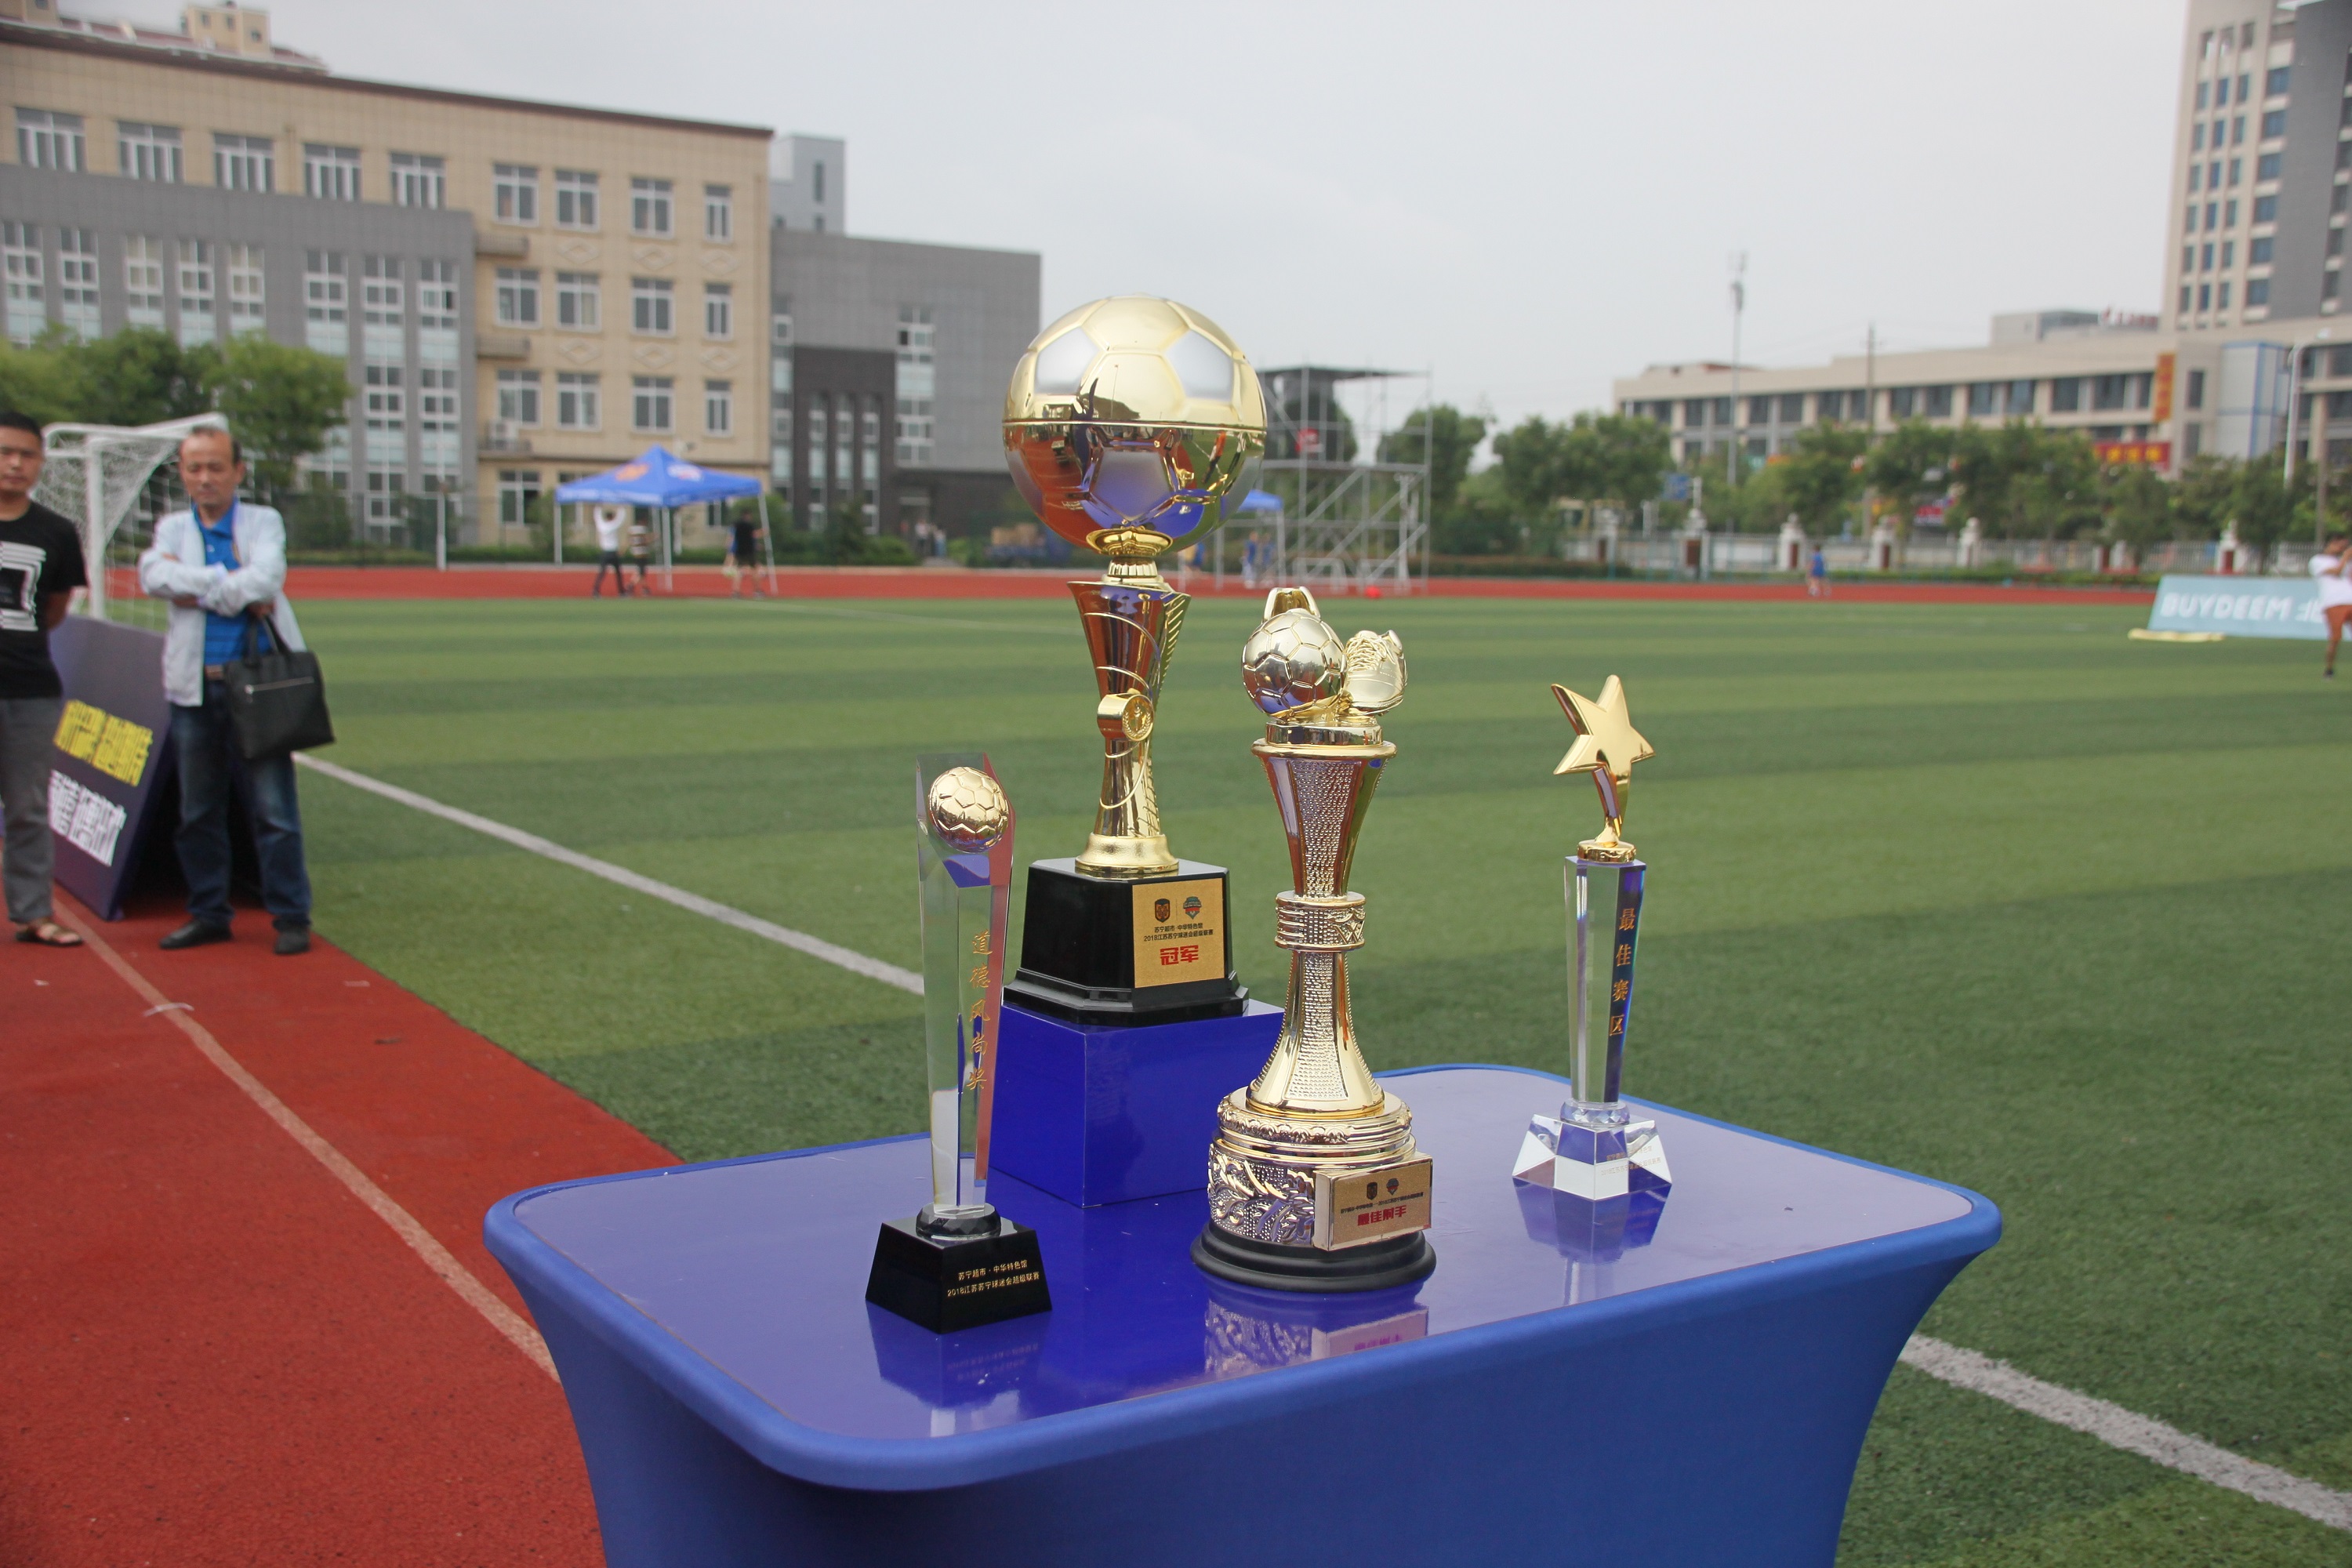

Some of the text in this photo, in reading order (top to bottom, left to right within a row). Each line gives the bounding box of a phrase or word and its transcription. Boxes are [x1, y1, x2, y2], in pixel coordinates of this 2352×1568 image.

[2160, 593, 2294, 621] BUYDEEM
[1160, 945, 1200, 966] 冠军
[1610, 908, 1636, 1037] 最佳赛区
[967, 929, 993, 1091] 道德风尚奖
